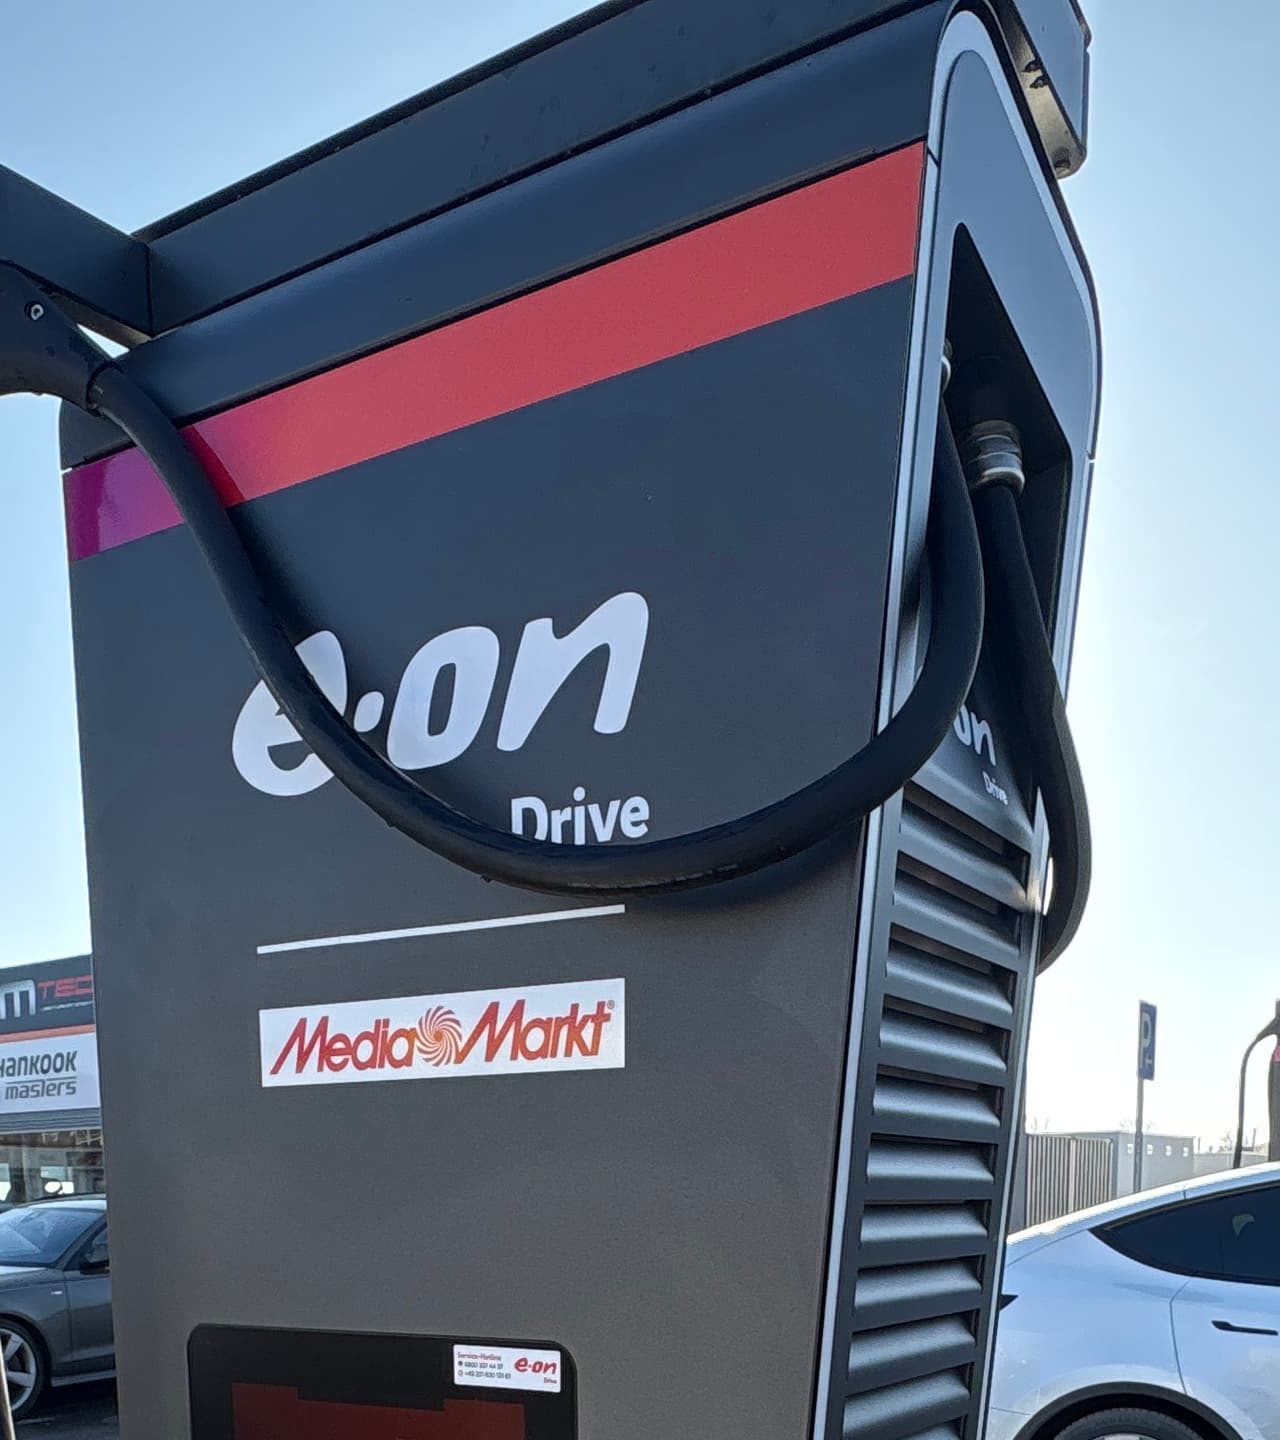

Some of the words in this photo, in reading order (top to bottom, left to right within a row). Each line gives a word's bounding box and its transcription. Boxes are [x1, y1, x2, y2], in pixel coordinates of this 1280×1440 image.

[982, 771, 1008, 805] Drive
[511, 787, 650, 844] Drive
[5, 1078, 77, 1100] masters
